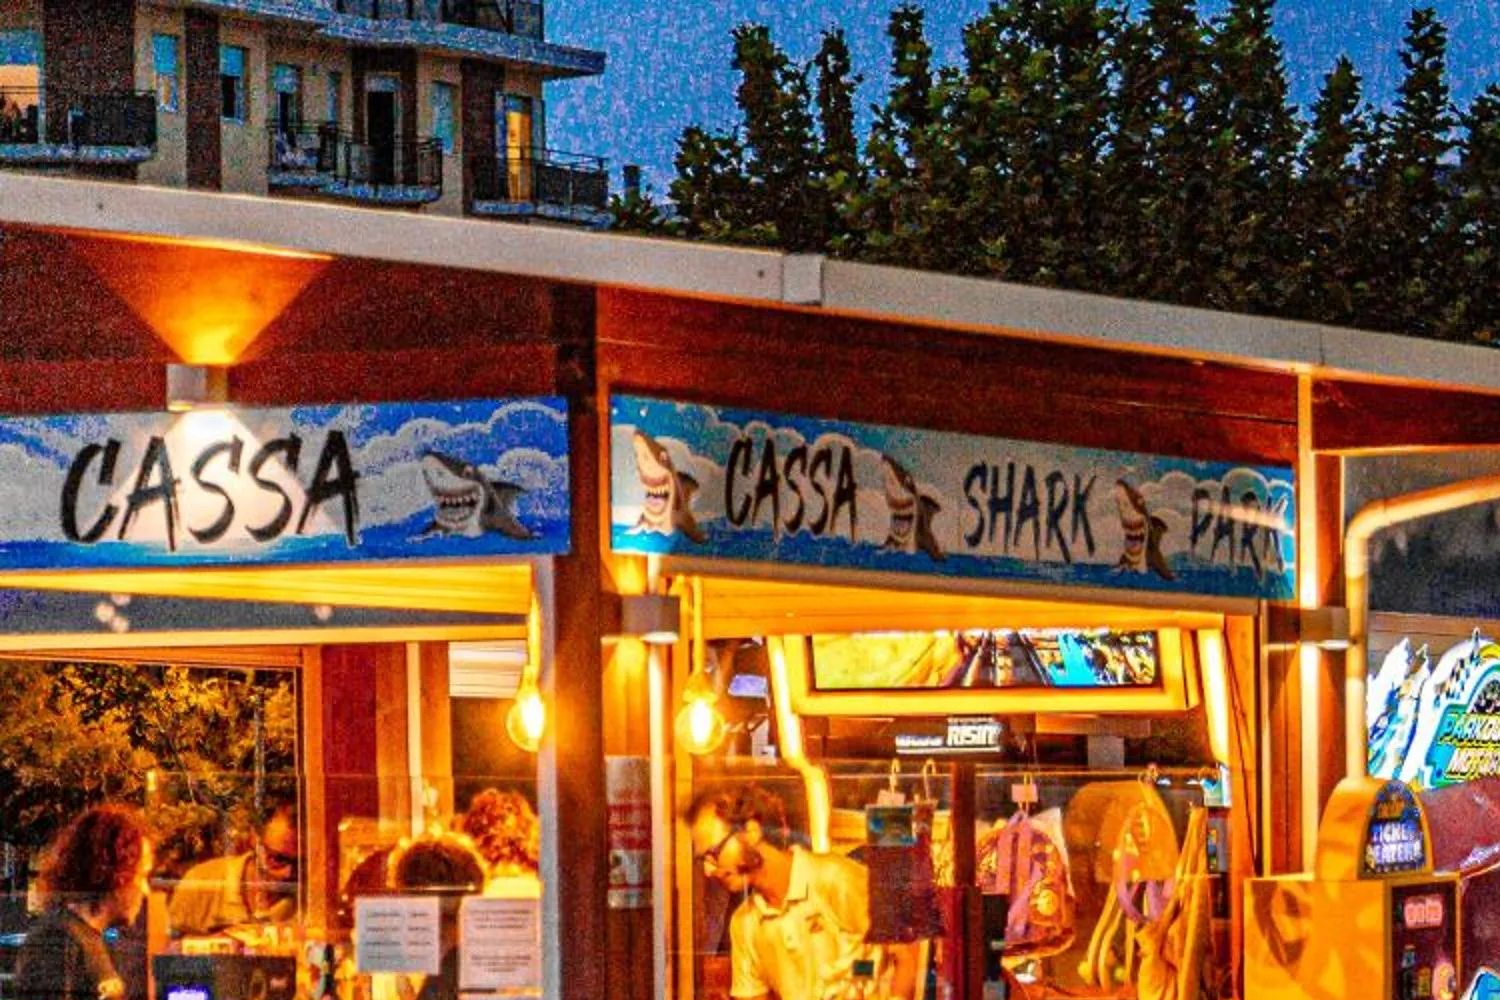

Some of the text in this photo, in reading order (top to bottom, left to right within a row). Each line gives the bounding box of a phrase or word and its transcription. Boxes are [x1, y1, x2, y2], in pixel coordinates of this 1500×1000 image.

[60, 430, 362, 552] CASSA
[723, 436, 1289, 580] CASSA SHARK PARK
